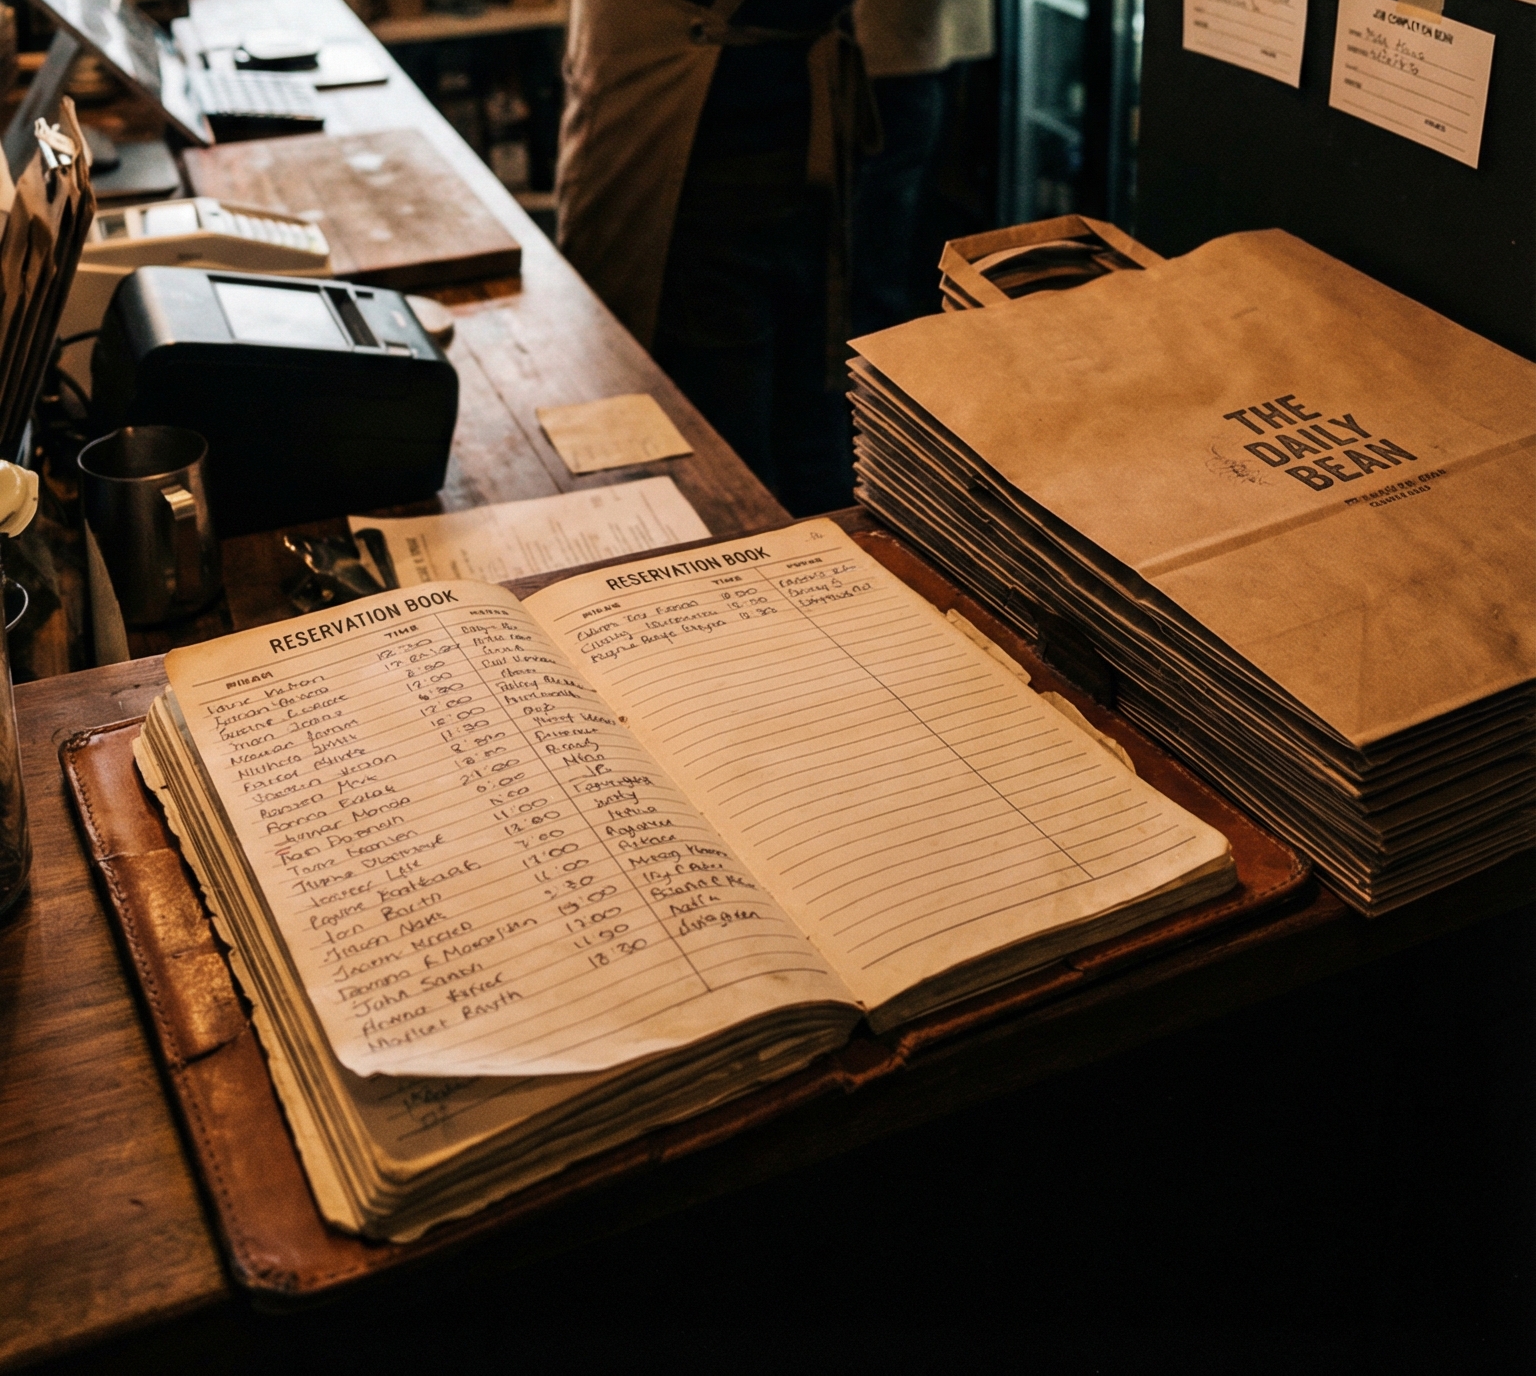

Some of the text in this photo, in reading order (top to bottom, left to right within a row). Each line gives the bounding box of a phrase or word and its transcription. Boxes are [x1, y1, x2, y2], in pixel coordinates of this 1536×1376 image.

[1222, 394, 1323, 436] THE
[1243, 413, 1372, 468] DAILY
[1284, 438, 1419, 492] BEAN
[605, 546, 771, 592] RESERVATION BOOK
[269, 589, 459, 654] RESERVATION BOOK
